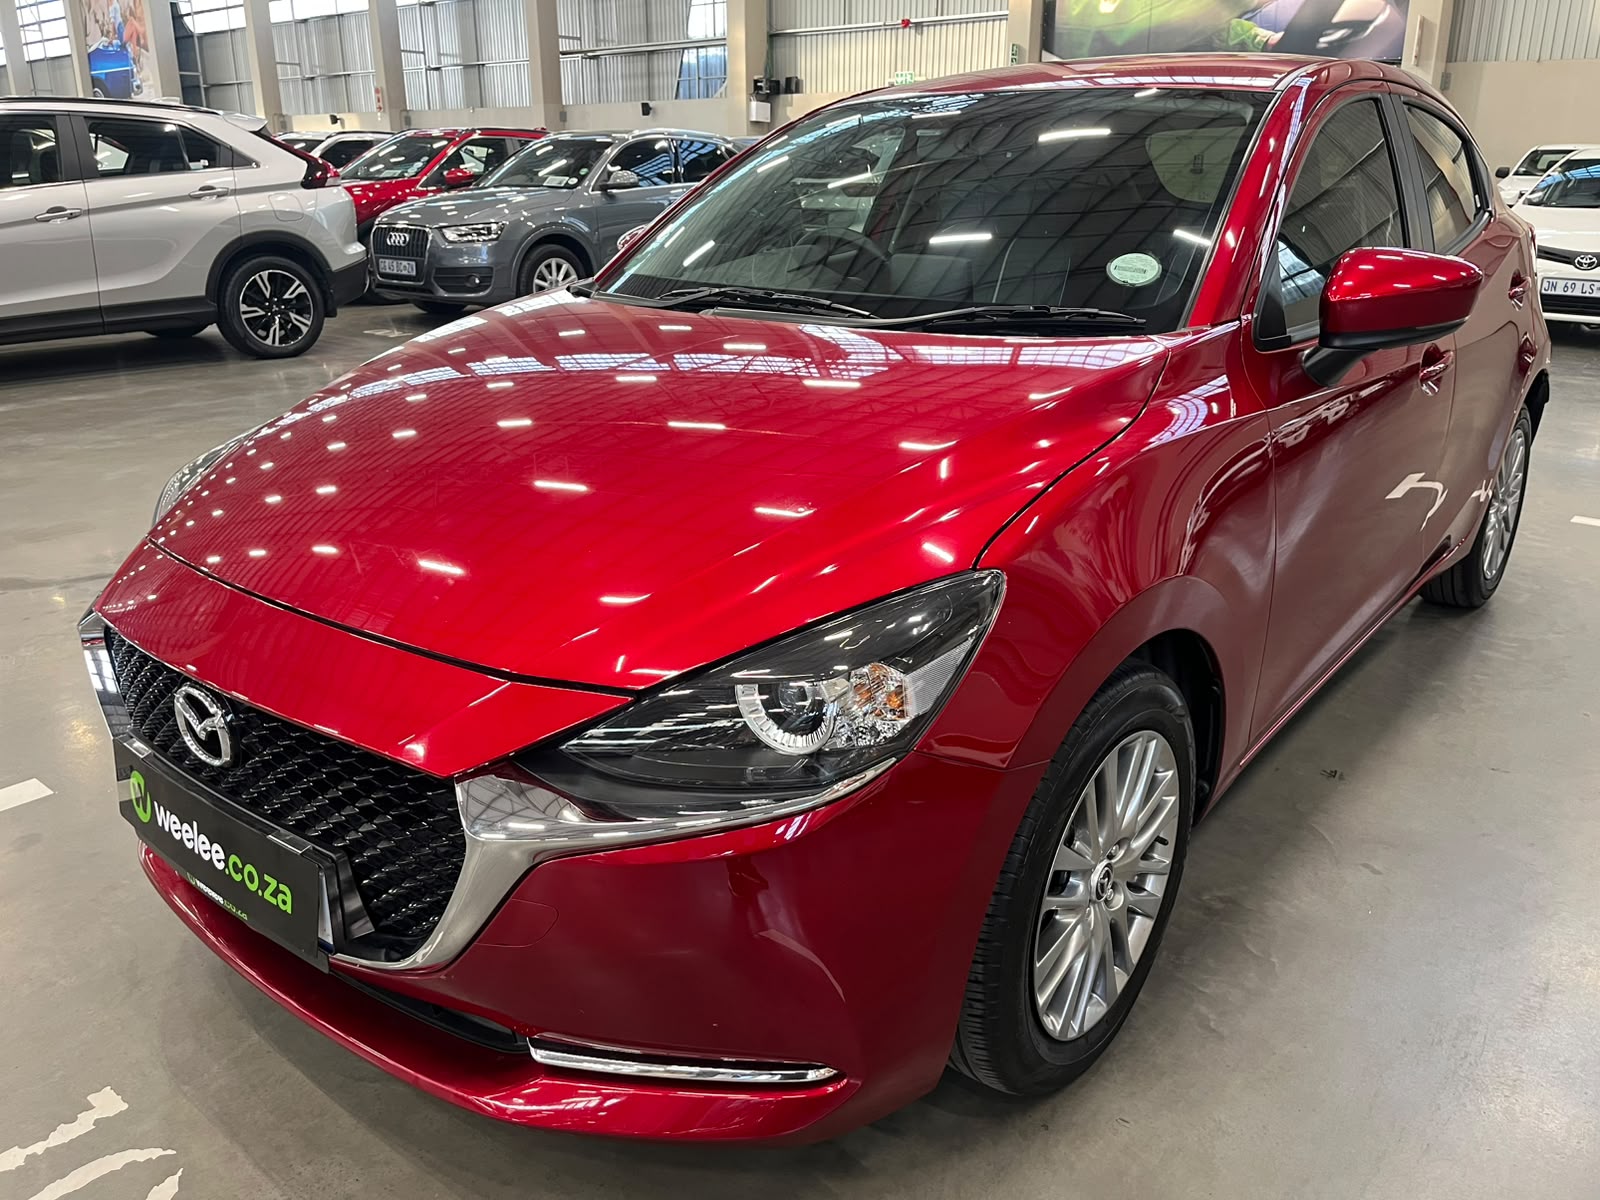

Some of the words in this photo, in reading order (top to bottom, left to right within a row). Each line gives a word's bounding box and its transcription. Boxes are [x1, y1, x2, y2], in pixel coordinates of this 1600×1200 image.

[1544, 281, 1557, 292] JN
[1563, 282, 1576, 293] 69
[1581, 283, 1595, 294] LS
[154, 800, 292, 914] weelee.co.za
